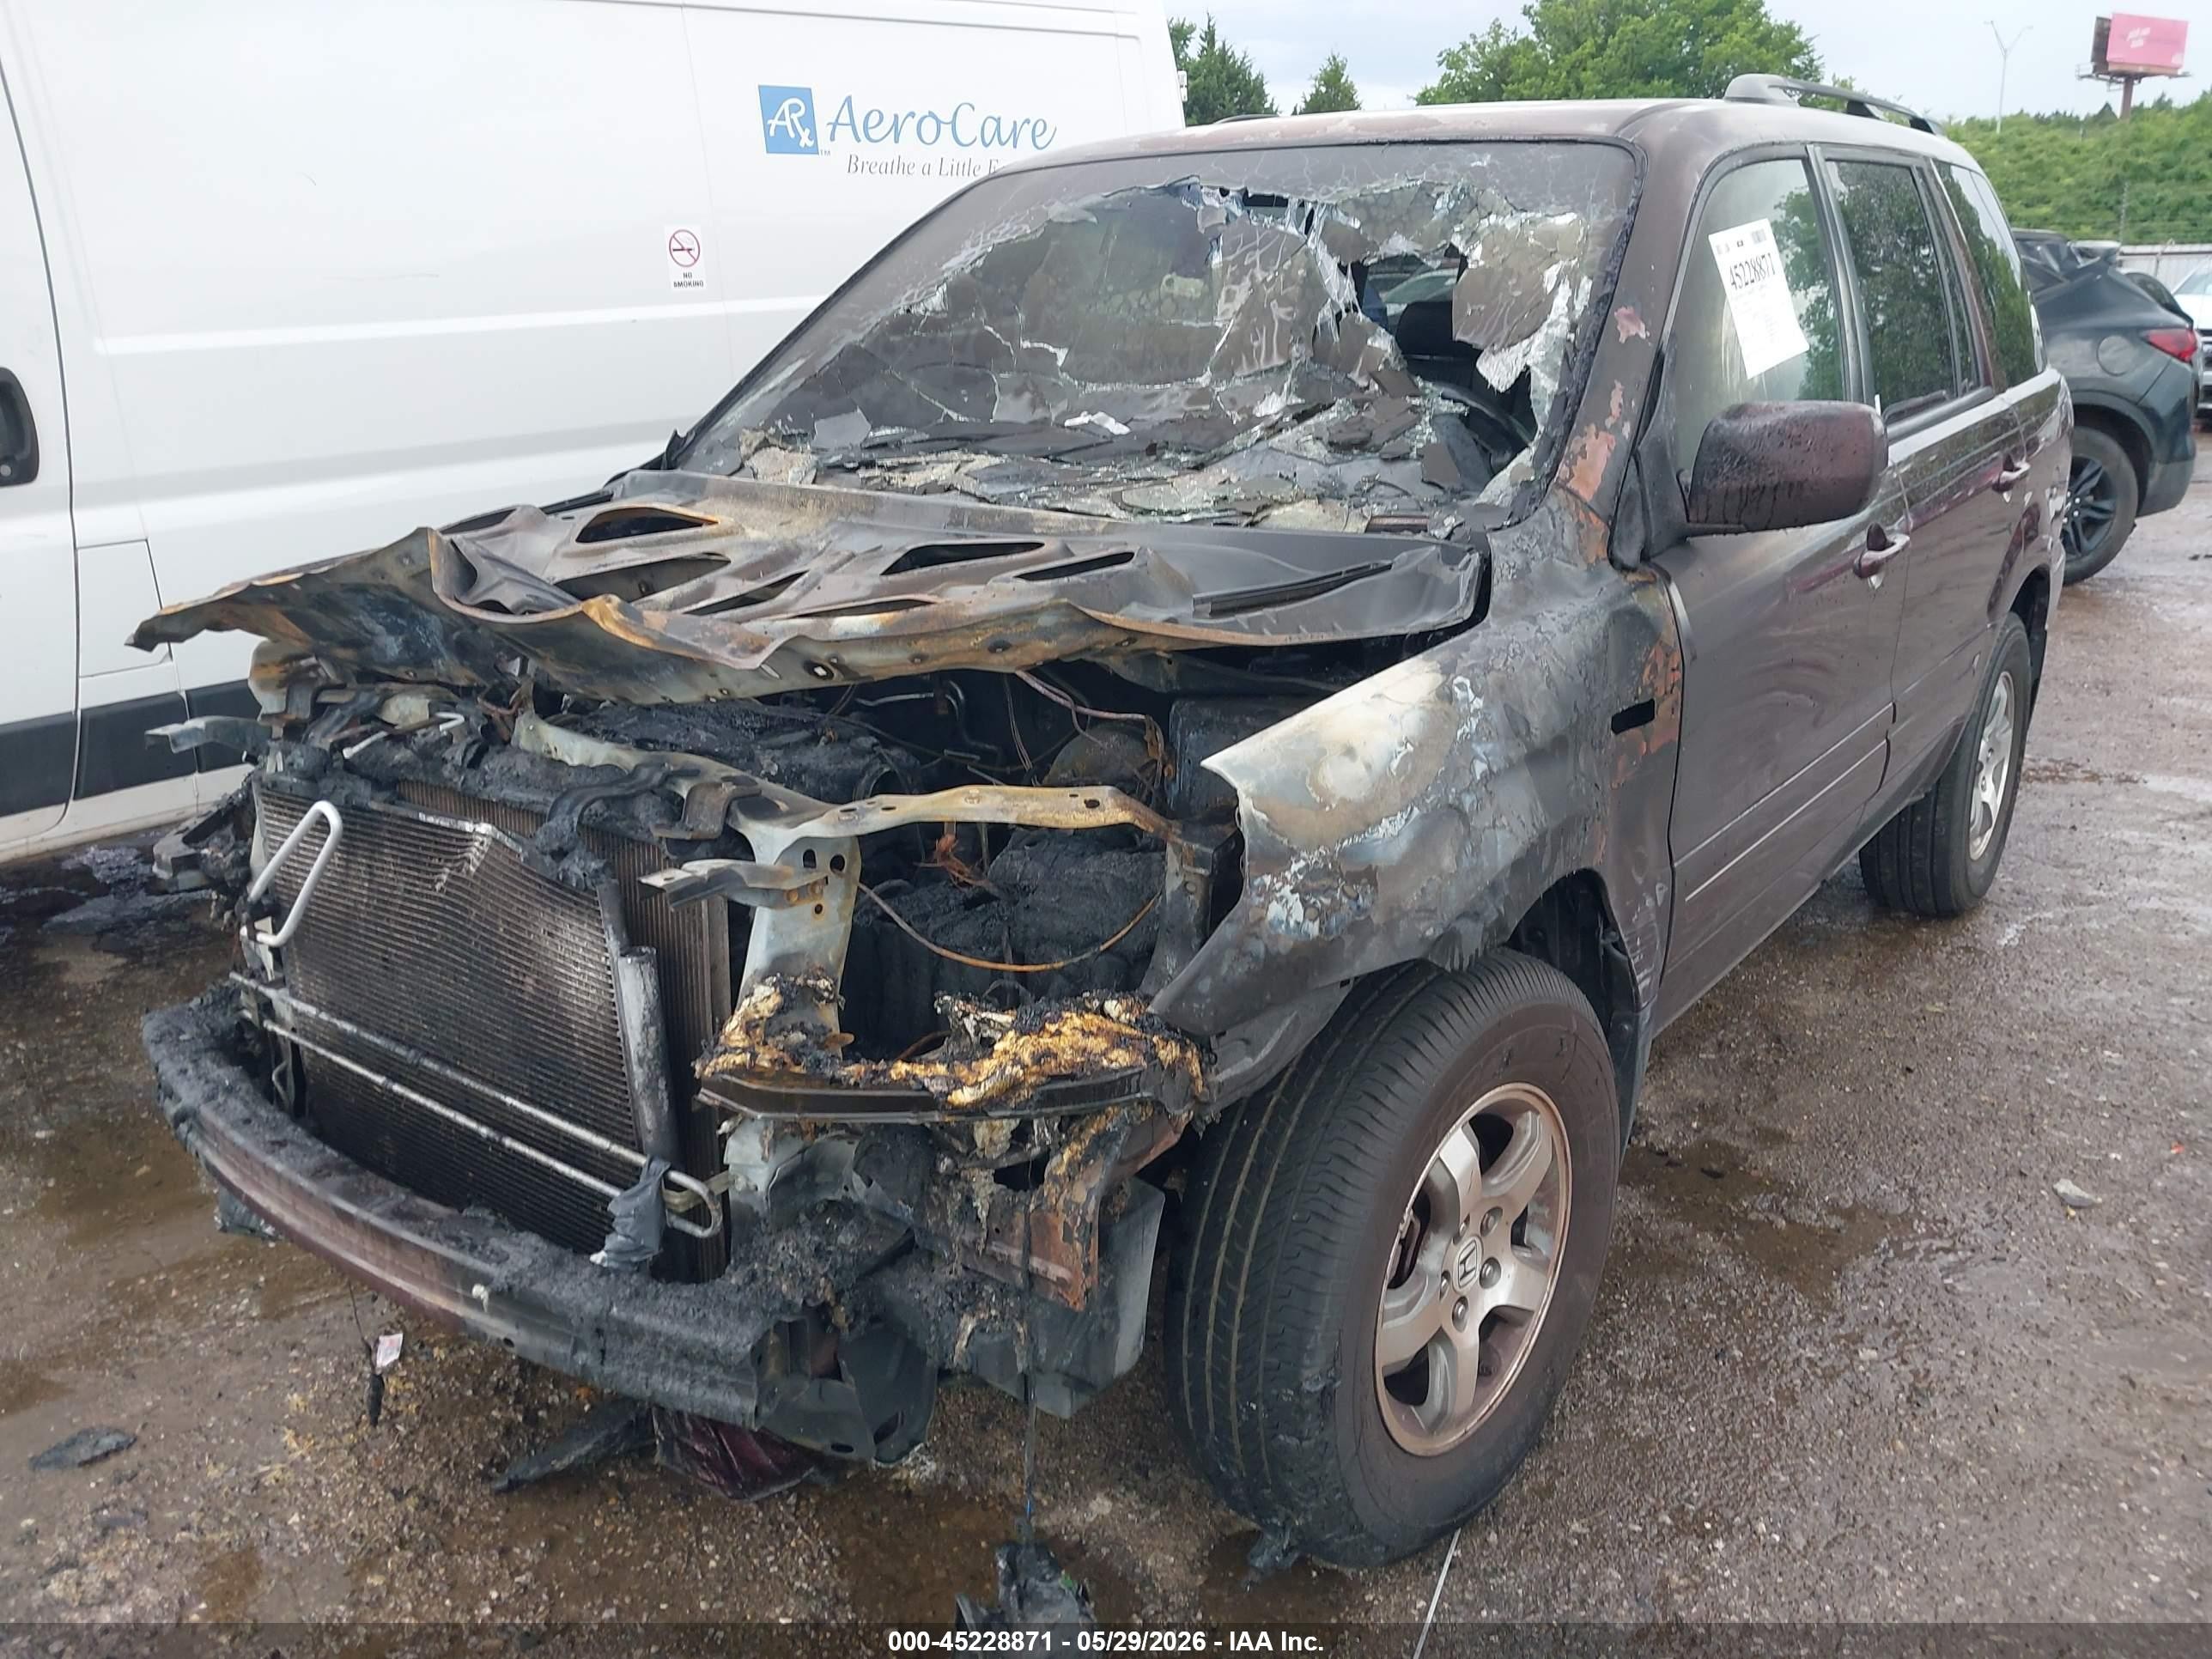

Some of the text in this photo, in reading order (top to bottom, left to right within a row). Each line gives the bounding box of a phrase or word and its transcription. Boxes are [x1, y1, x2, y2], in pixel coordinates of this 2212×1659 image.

[827, 94, 1057, 151] AeroCare
[848, 153, 915, 176] Breathe
[921, 163, 931, 176] a
[939, 157, 981, 177] Little
[1729, 252, 1776, 290] 45228871
